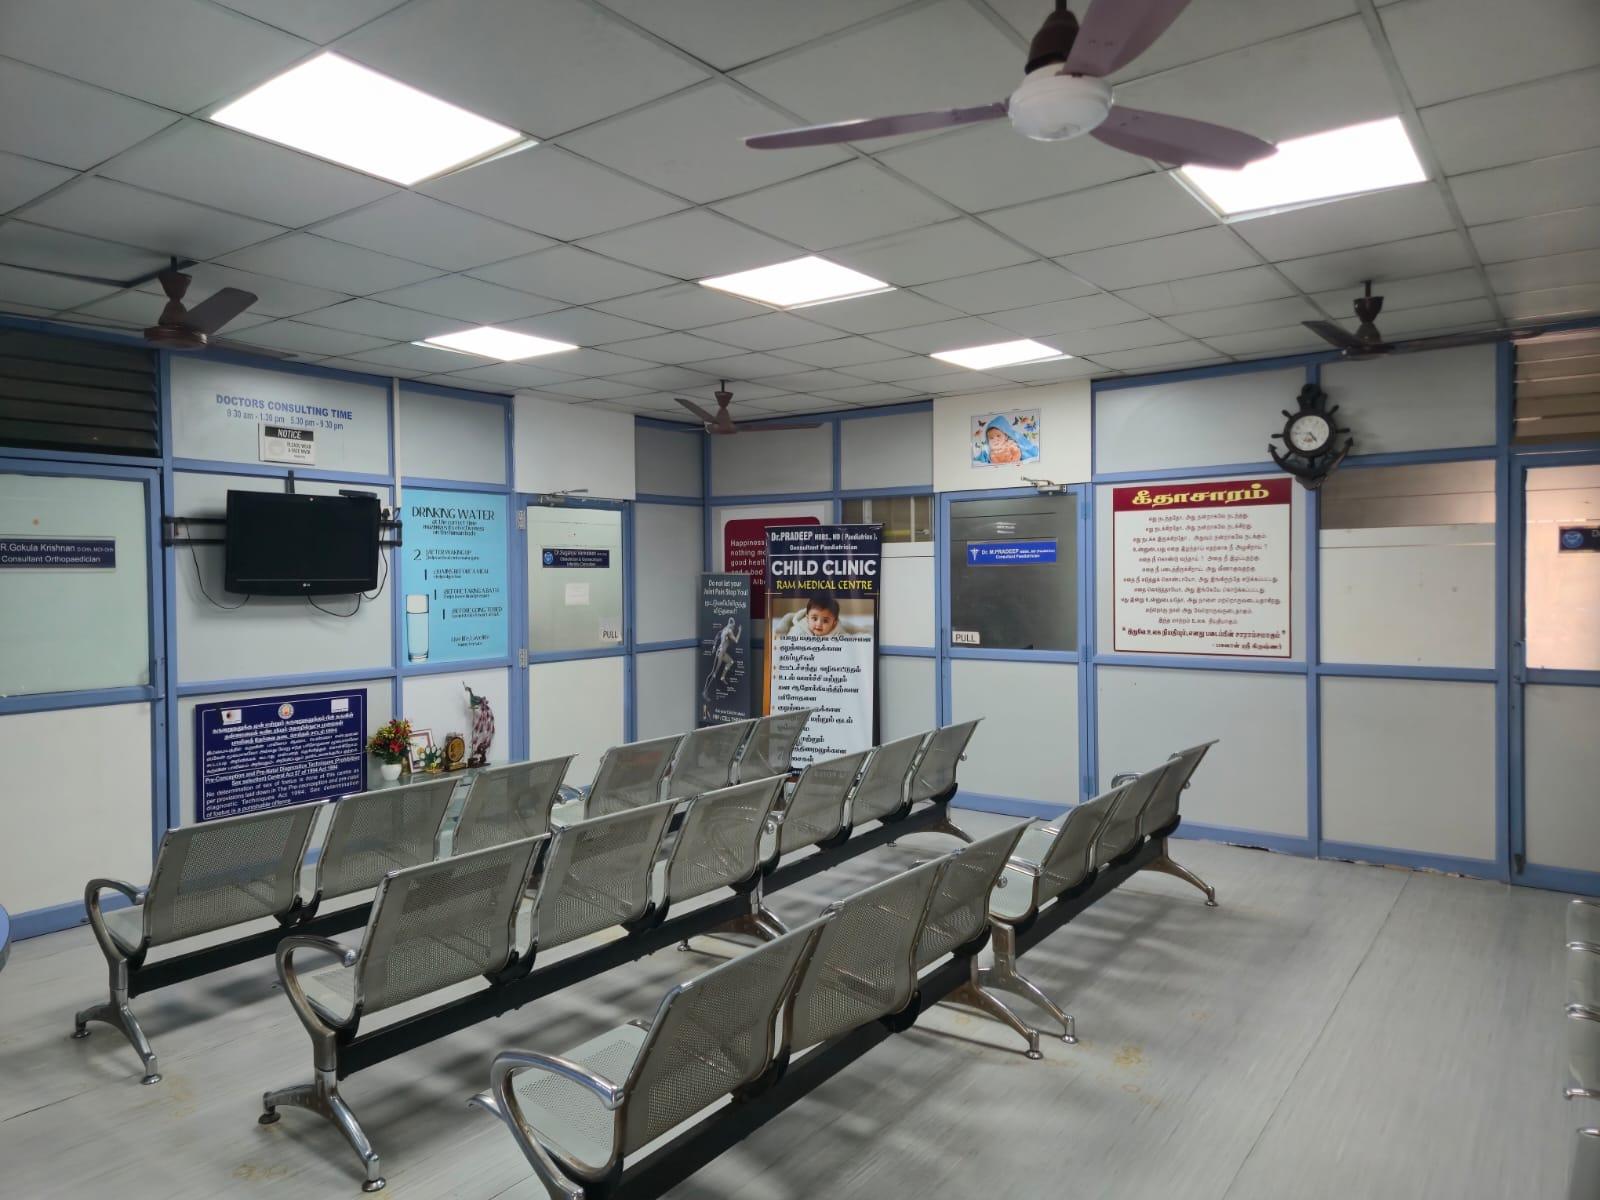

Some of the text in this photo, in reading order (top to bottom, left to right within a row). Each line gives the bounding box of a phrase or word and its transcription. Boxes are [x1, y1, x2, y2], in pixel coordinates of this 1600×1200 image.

[216, 394, 354, 420] DOCTORS CONSULTING TIME
[274, 415, 285, 424] pm
[304, 419, 315, 428] pm
[334, 422, 344, 431] pm
[278, 429, 302, 439] NOTICE
[1132, 483, 1269, 508] கீதாசாரம்
[412, 506, 495, 521] DRINKING WATER
[771, 531, 813, 541] Dr.PRADEEP
[40, 543, 75, 552] Krishnan
[413, 549, 422, 560] 2
[730, 549, 755, 557] nothing
[1, 555, 101, 564] Consultant Orthopaedician
[730, 558, 747, 567] good
[771, 559, 877, 576] CHILD CLINIC
[776, 580, 796, 590] RAM
[797, 580, 836, 590] MEDICAL
[838, 580, 873, 590] CENTRE
[602, 630, 618, 639] PULL
[955, 633, 976, 642] PULL
